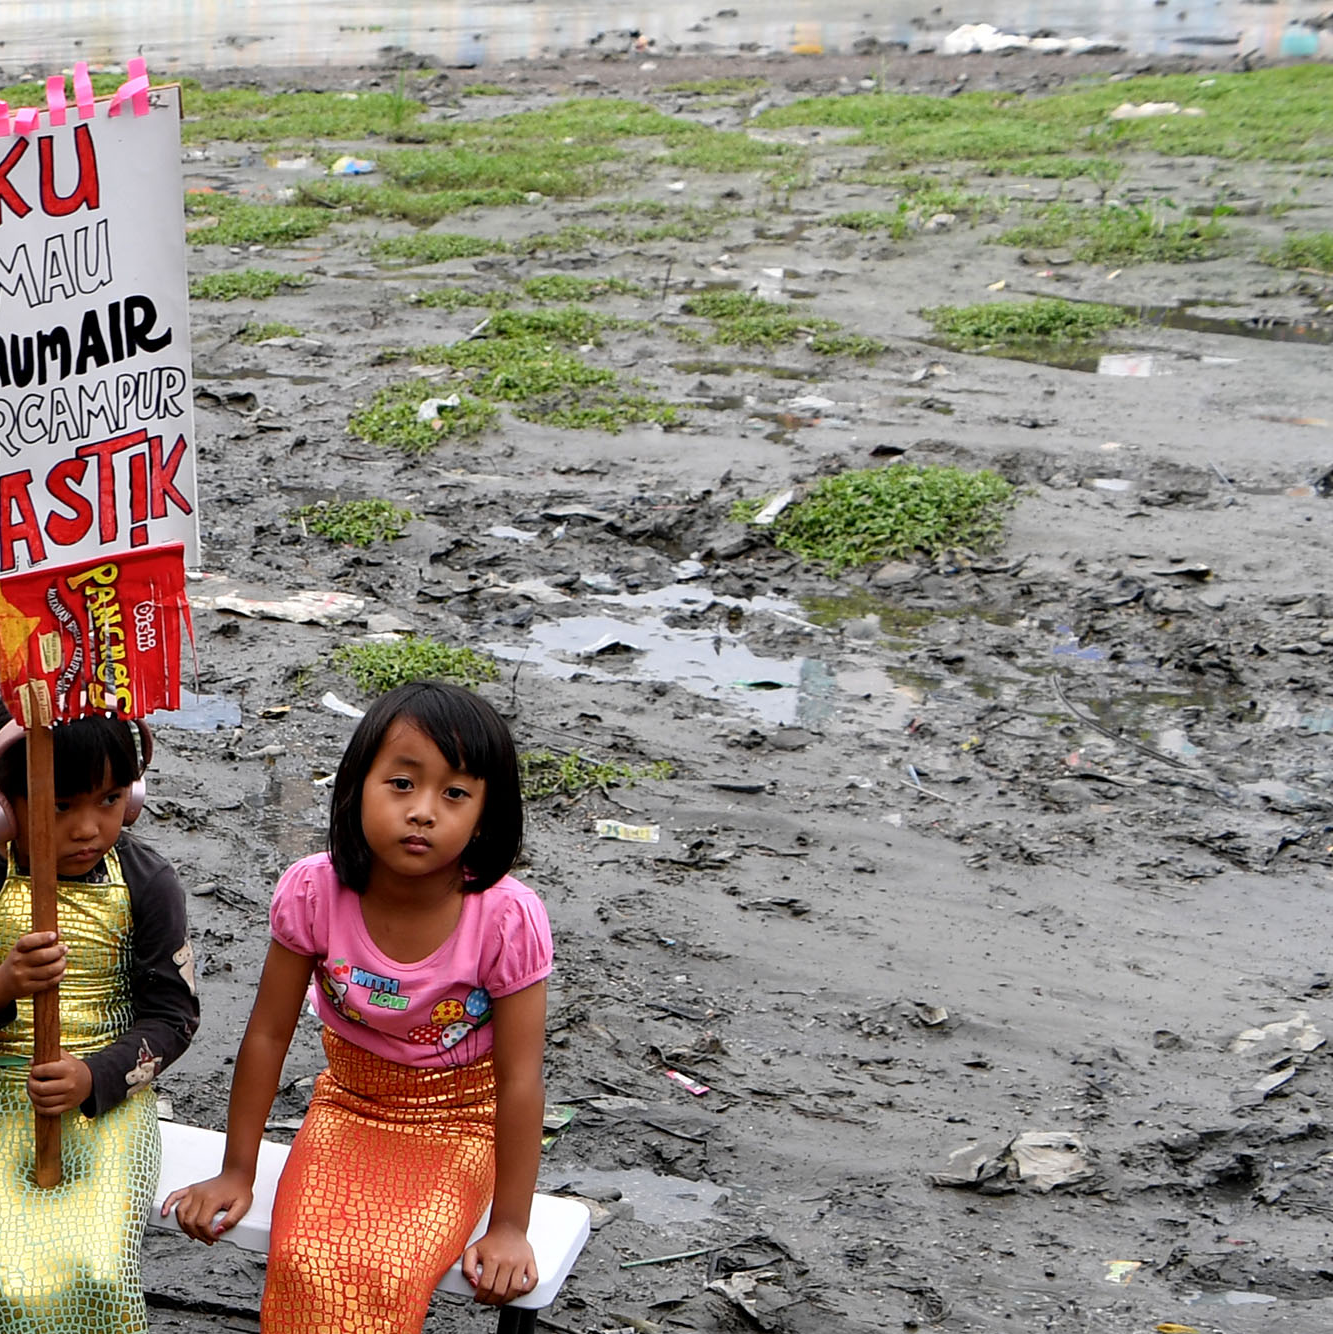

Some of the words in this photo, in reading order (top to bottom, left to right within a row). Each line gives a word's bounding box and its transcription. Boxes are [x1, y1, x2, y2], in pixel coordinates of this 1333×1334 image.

[133, 600, 157, 652] Oishi
[350, 965, 400, 994] WITH
[368, 991, 411, 1011] LOVE
